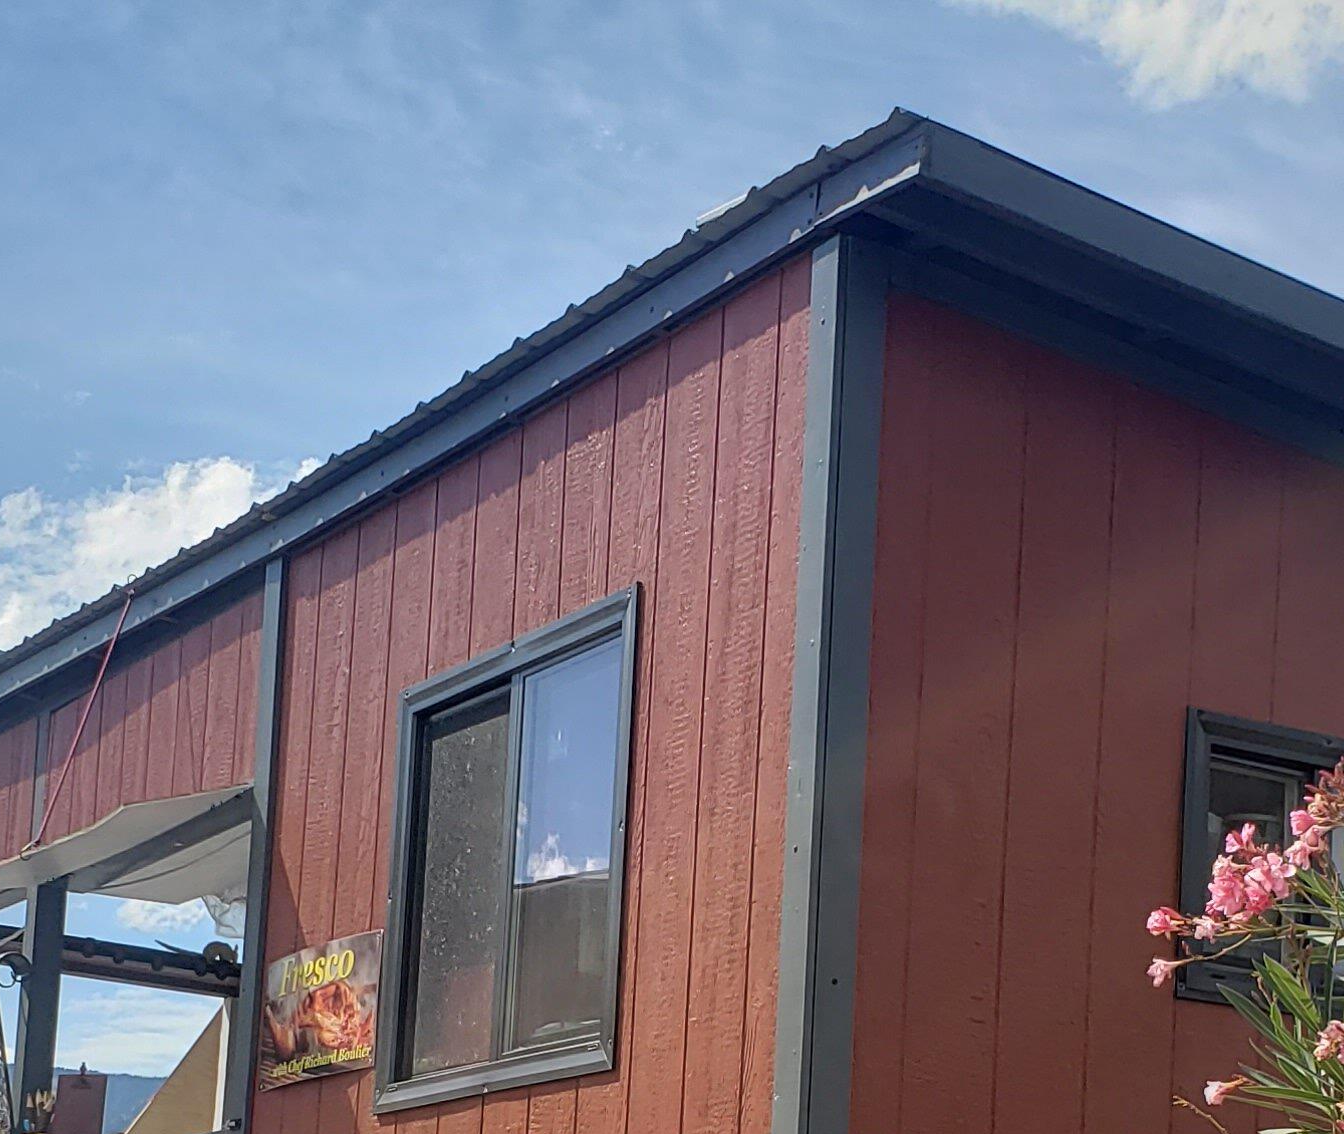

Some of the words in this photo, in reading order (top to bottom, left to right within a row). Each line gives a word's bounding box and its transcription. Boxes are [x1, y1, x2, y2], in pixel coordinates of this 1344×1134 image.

[278, 949, 355, 997] Fresco
[288, 1056, 306, 1074] Chef
[304, 1048, 338, 1070] Richard
